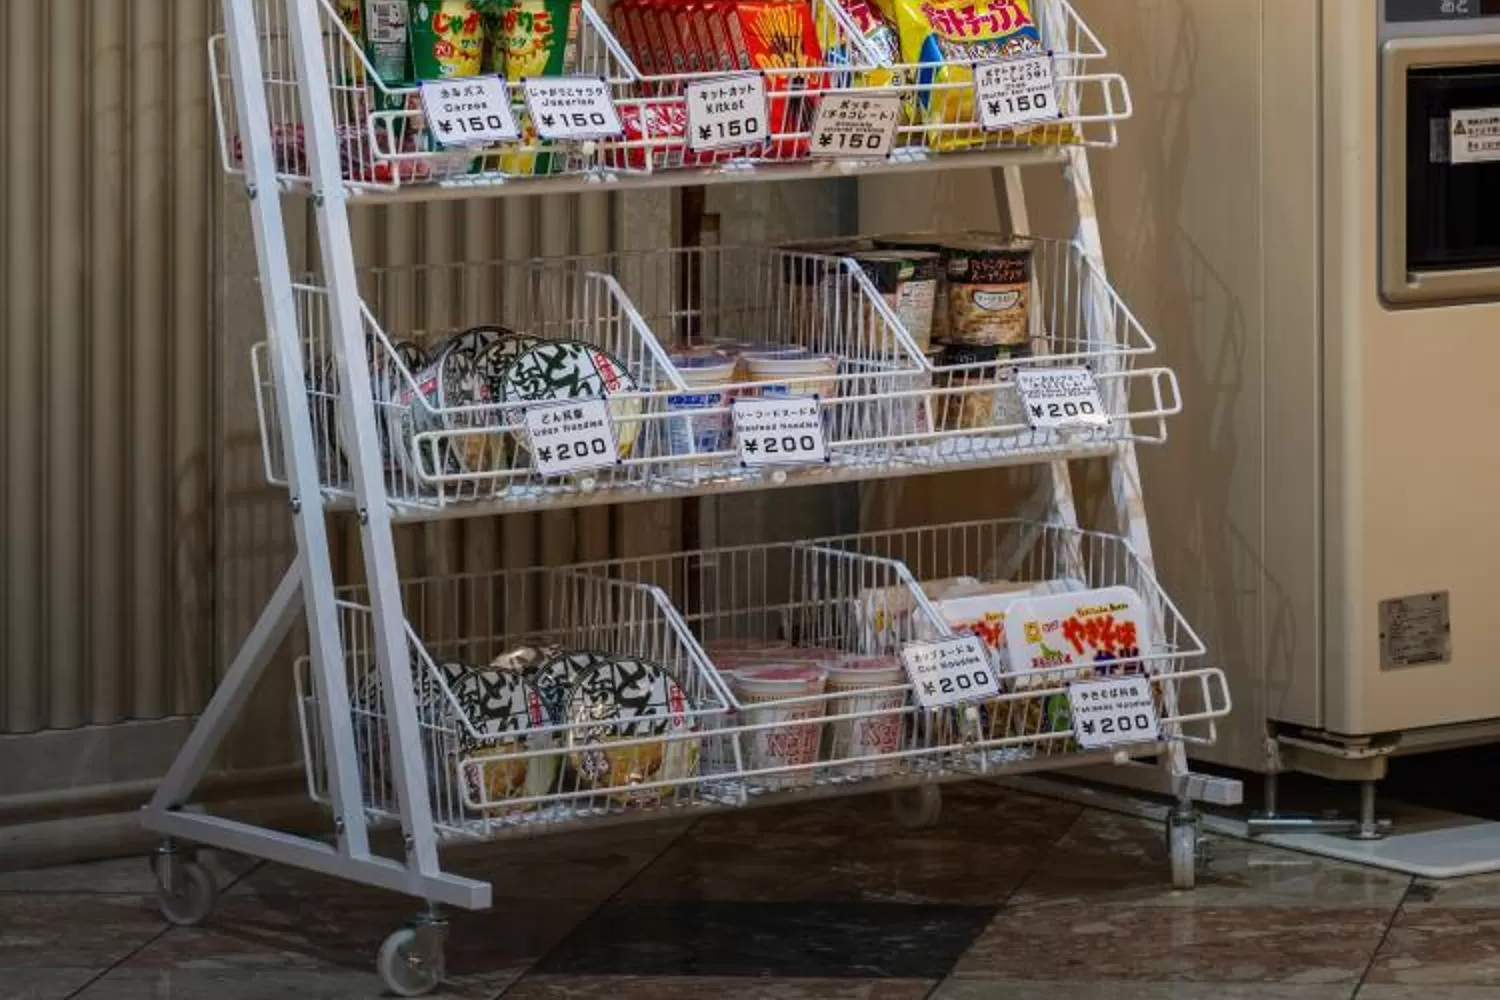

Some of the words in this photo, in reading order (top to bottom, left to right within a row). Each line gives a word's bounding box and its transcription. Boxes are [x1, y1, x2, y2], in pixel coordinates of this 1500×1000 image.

[699, 84, 756, 101] キットカット
[839, 99, 882, 111] ポッキー
[987, 93, 1048, 115] ¥150
[437, 114, 502, 134] ¥150
[541, 111, 606, 128] ¥150
[699, 117, 759, 141] ¥150
[818, 133, 882, 150] ¥150
[737, 407, 818, 420] シーフードヌードル
[1029, 400, 1096, 420] ¥200
[537, 437, 608, 464] ¥200
[743, 434, 816, 455] ¥200
[922, 670, 990, 695] ¥200
[1081, 713, 1150, 735] ¥200
